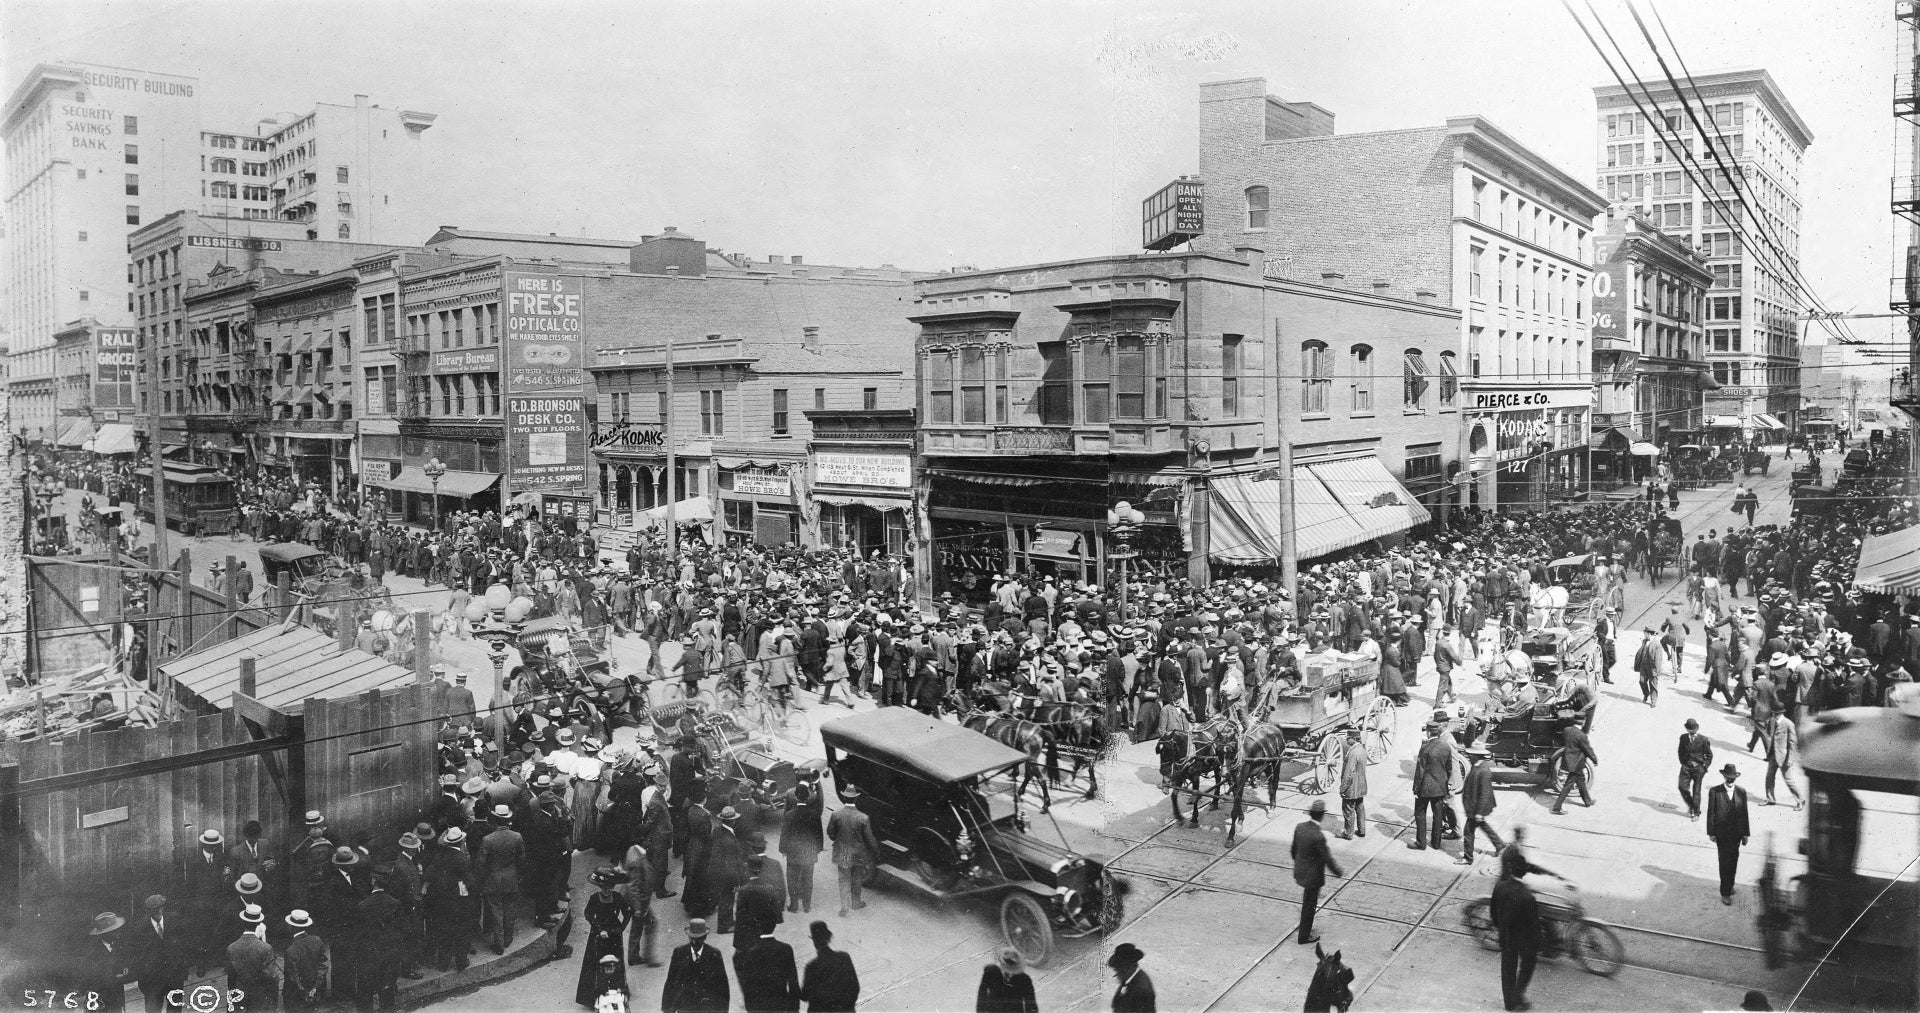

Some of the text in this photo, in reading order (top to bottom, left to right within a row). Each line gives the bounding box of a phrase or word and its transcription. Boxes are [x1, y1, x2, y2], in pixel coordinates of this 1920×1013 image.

[84, 71, 194, 98] SECURITY BUILDING
[62, 104, 114, 121] SECURITY
[66, 120, 112, 136] SAVINGS
[71, 136, 107, 150] BANK
[1177, 184, 1203, 196] BANK
[1177, 211, 1203, 219] NIGHT
[193, 236, 244, 249] LISSNER
[518, 278, 563, 292] HERE IS
[509, 292, 580, 317] FRESE
[509, 316, 581, 332] OPTICAL CO.
[509, 332, 519, 341] WE
[519, 333, 535, 341] MAKE
[435, 352, 495, 367] Library Bureau
[524, 376, 543, 385] 546
[1722, 389, 1749, 397] SHOES
[1476, 393, 1521, 409] PIERCE
[1523, 395, 1533, 406] &
[518, 413, 576, 425] DESK CO.
[1499, 416, 1549, 442] KODAKS
[621, 429, 664, 446] KODAKS
[1507, 459, 1529, 473] 127
[526, 476, 546, 485] 542
[823, 475, 857, 483] HOWE
[737, 485, 761, 493] HOWE
[939, 550, 1002, 572] BANK
